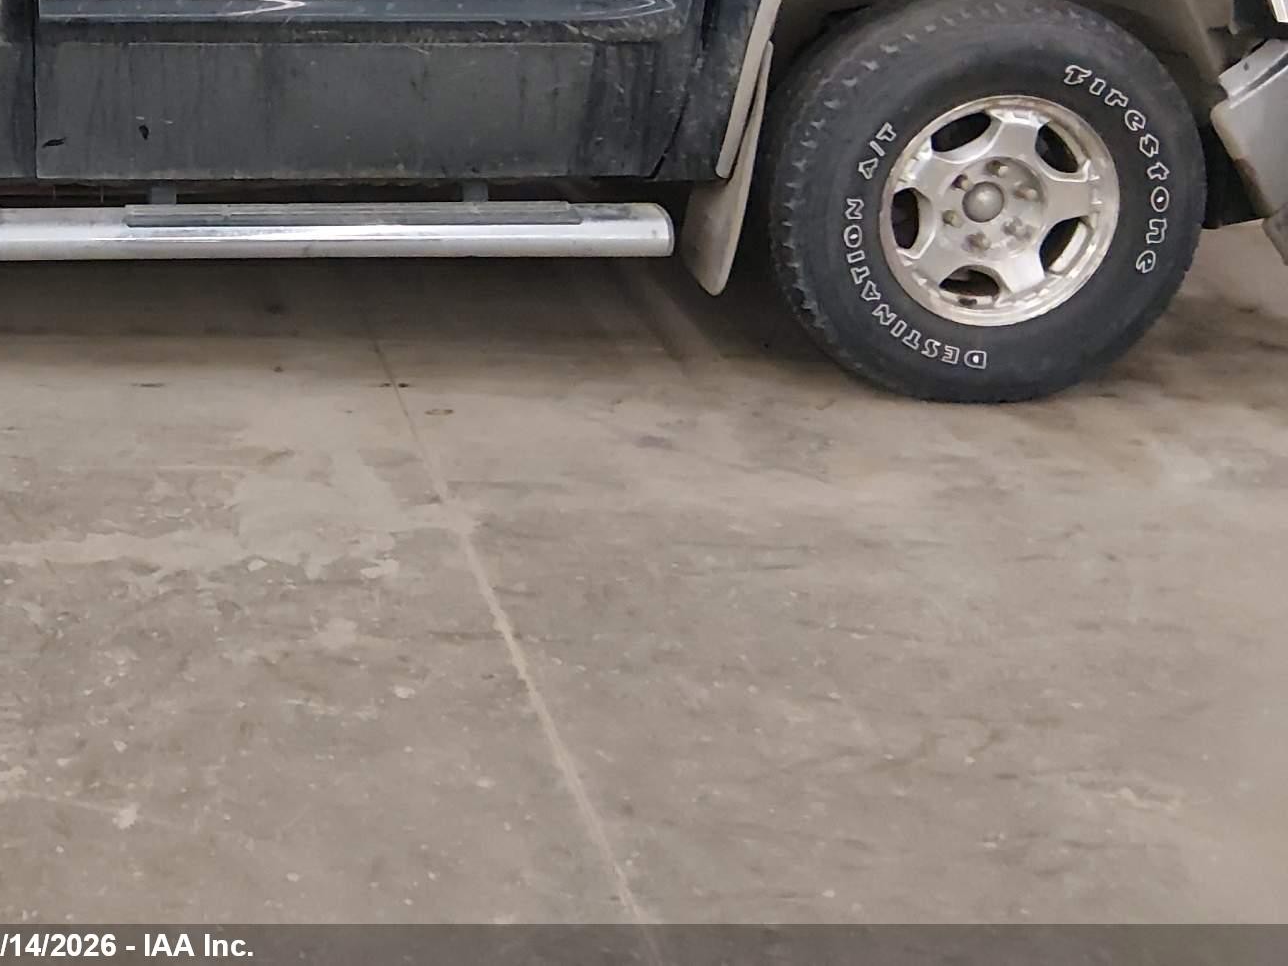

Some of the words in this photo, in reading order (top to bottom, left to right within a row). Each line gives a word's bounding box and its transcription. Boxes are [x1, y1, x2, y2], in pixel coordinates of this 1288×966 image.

[858, 122, 897, 181] A/T
[1065, 64, 1171, 274] Firestone
[843, 197, 988, 371] DESTINATION
